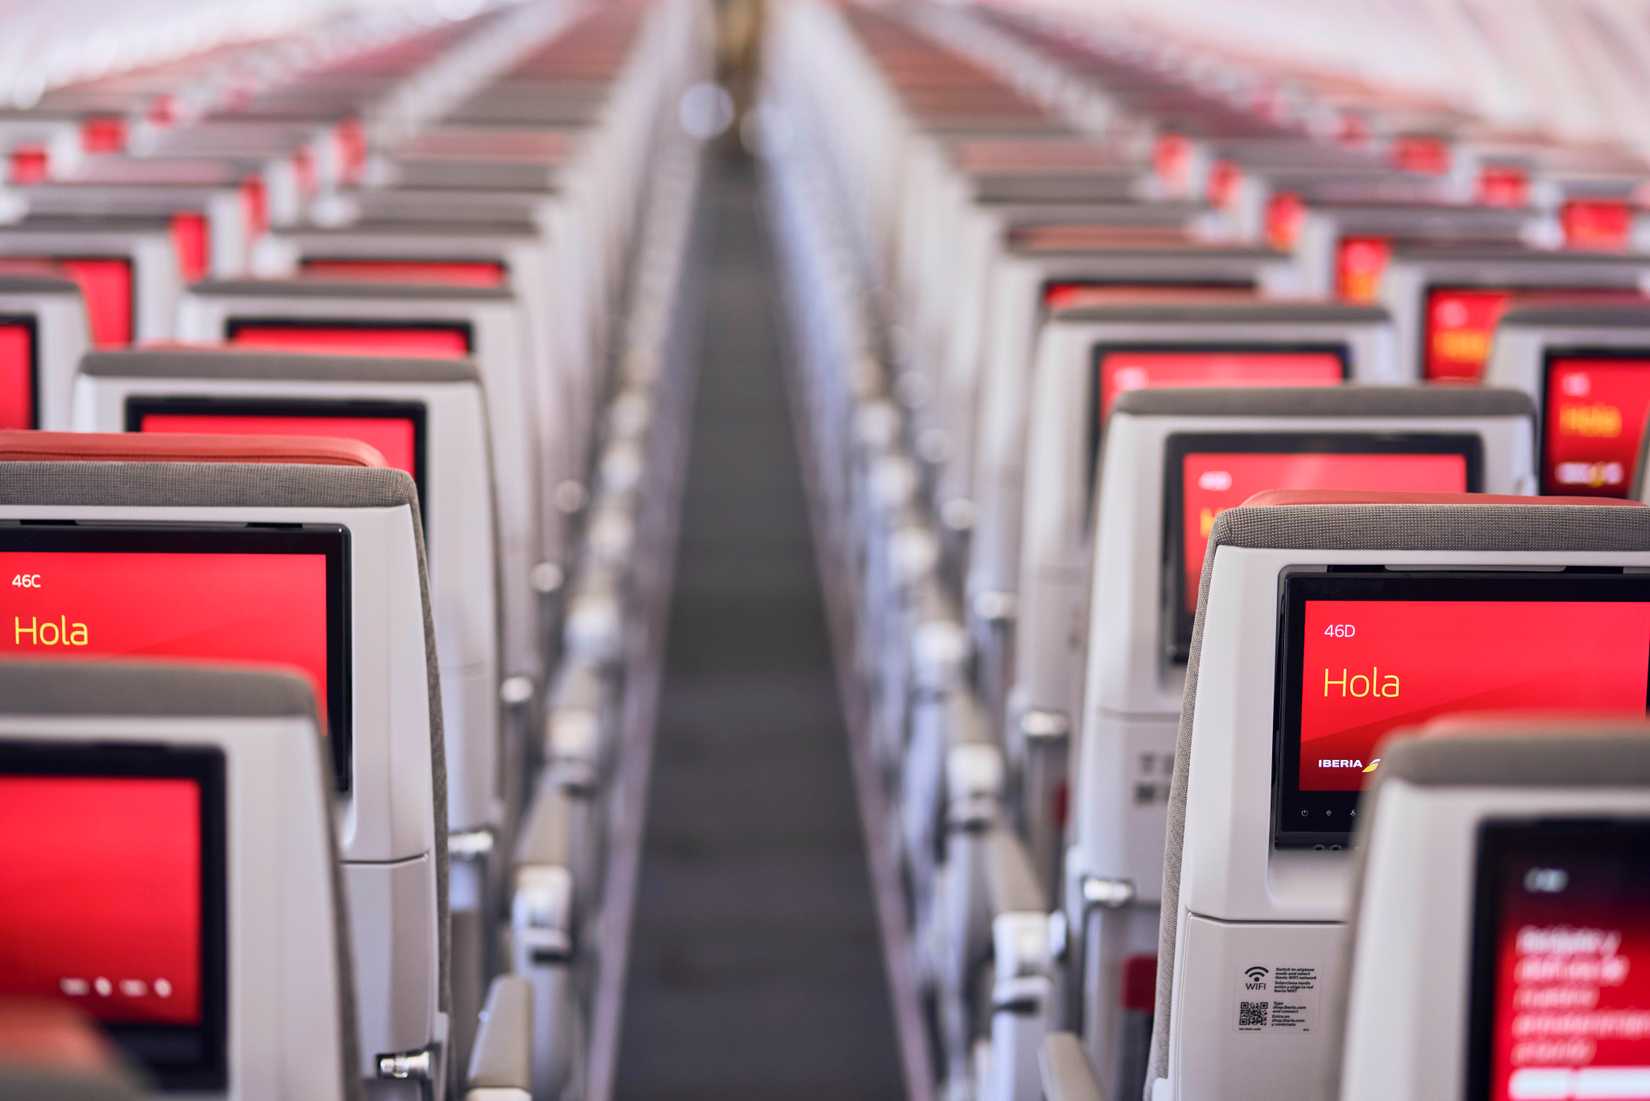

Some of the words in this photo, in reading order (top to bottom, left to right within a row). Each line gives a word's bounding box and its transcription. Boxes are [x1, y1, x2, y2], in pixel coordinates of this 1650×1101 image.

[11, 574, 41, 588] 46C
[15, 614, 88, 646] Hola
[1324, 624, 1356, 638] 46D
[1323, 666, 1400, 698] Hola
[1318, 759, 1363, 768] IBERIA
[1245, 983, 1266, 991] WIFI
